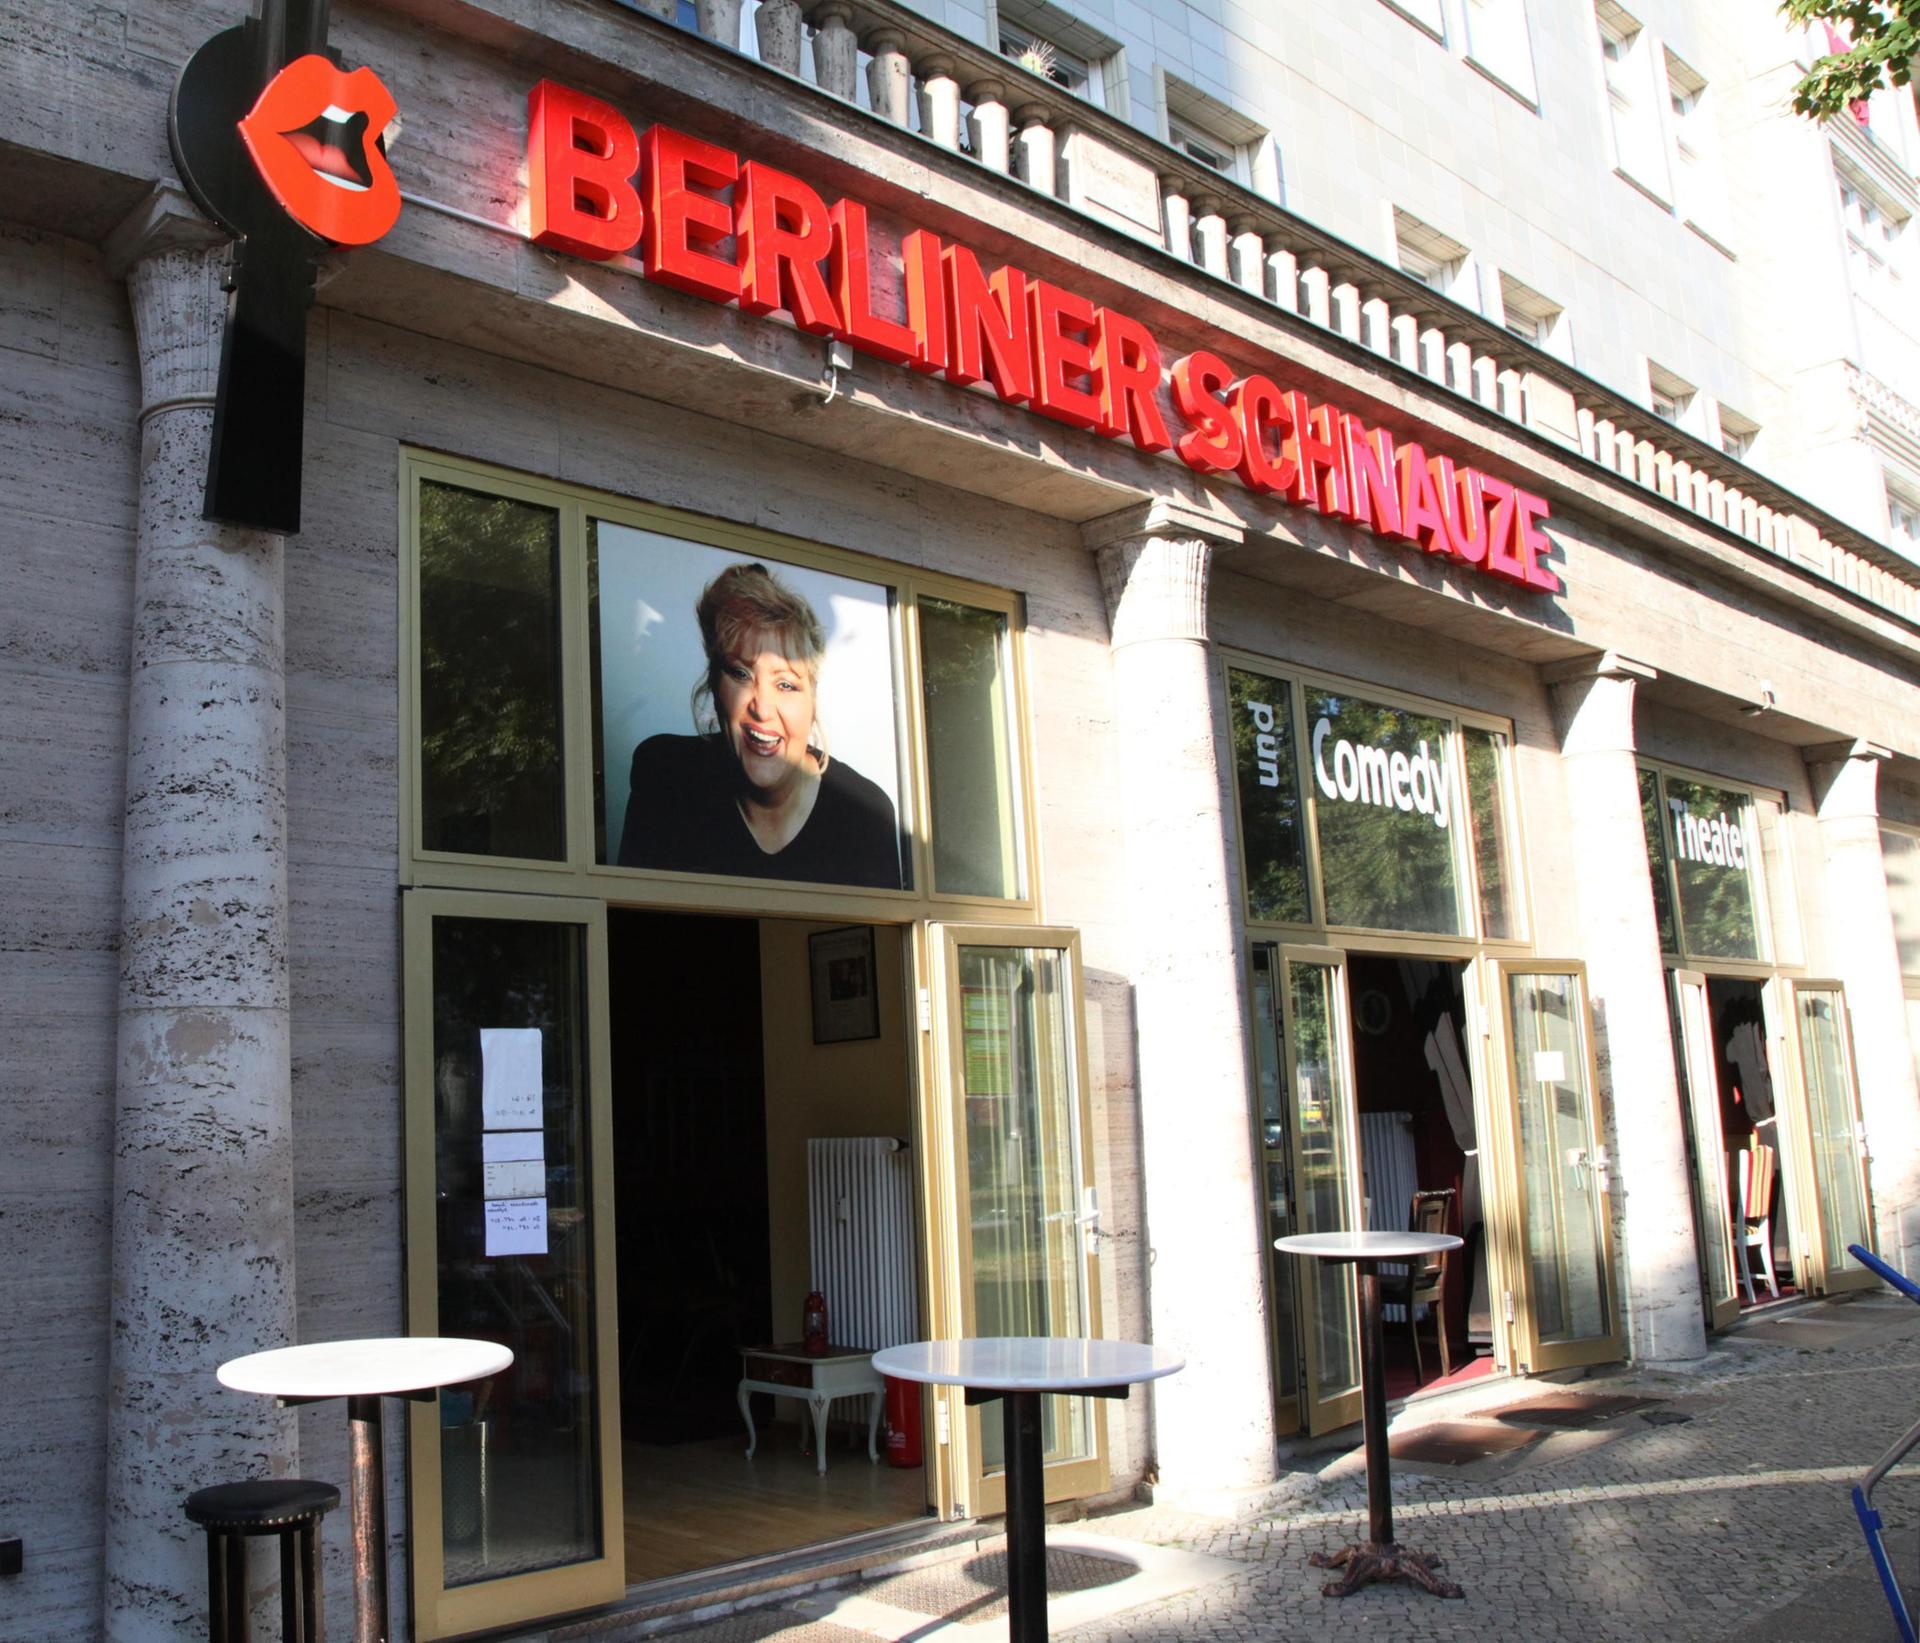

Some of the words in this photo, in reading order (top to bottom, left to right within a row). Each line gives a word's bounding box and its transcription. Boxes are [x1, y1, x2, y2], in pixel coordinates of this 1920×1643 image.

[528, 79, 1170, 452] BERLINER
[1171, 351, 1559, 593] SCHNAUZE
[1248, 701, 1280, 788] und
[1313, 718, 1450, 828] Comedy
[1668, 798, 1748, 870] Theate
